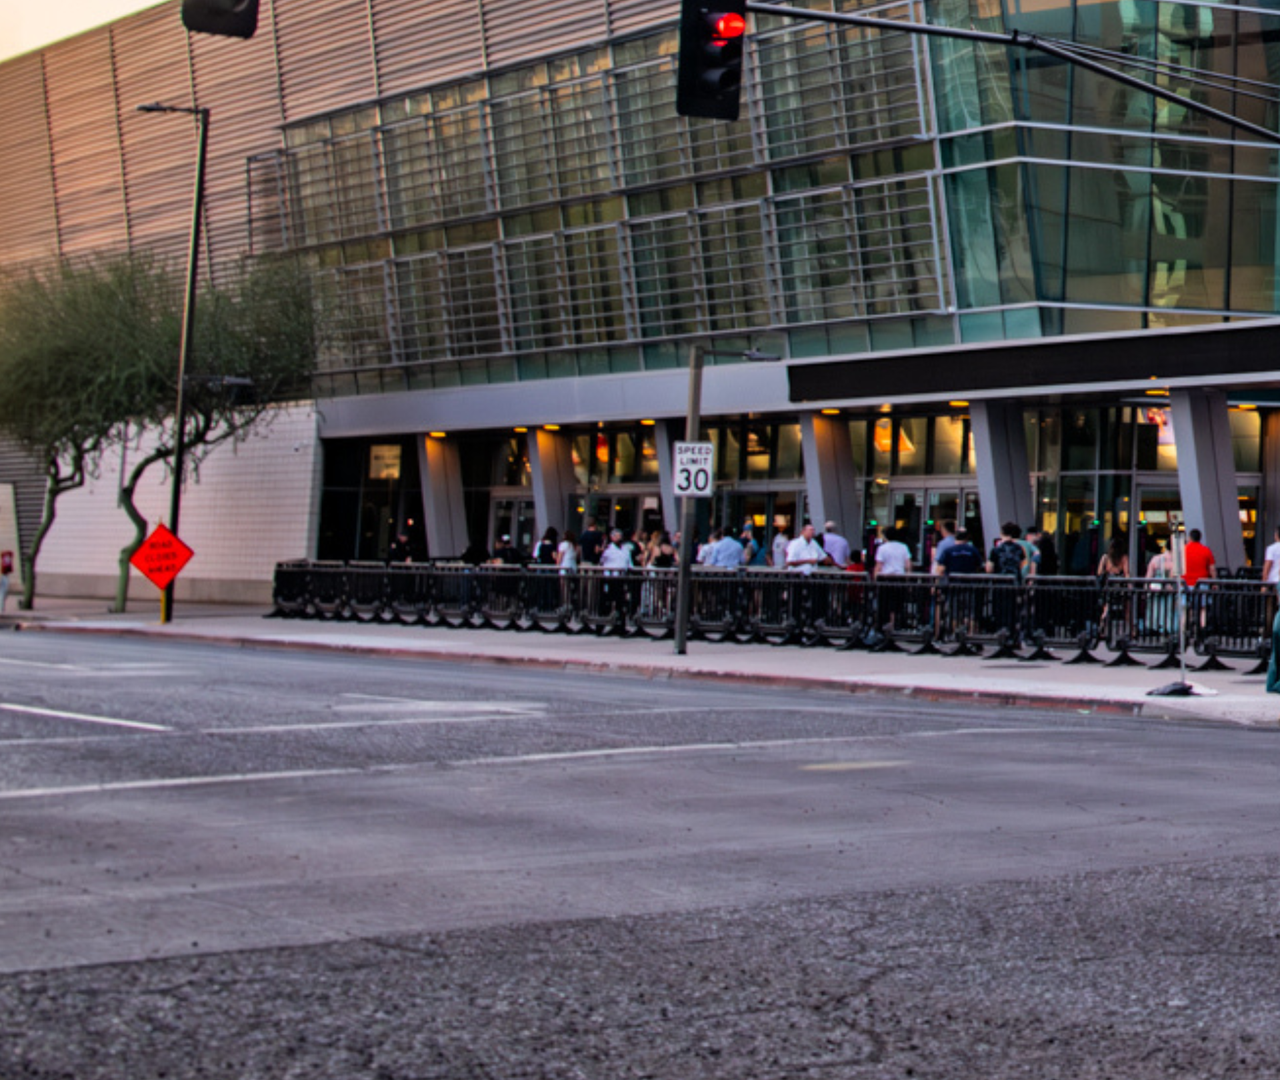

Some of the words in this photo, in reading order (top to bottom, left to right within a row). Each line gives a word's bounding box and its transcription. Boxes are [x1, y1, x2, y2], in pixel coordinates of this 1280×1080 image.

[677, 445, 712, 455] SPEED
[680, 457, 709, 466] LIMIT
[677, 468, 709, 492] 30
